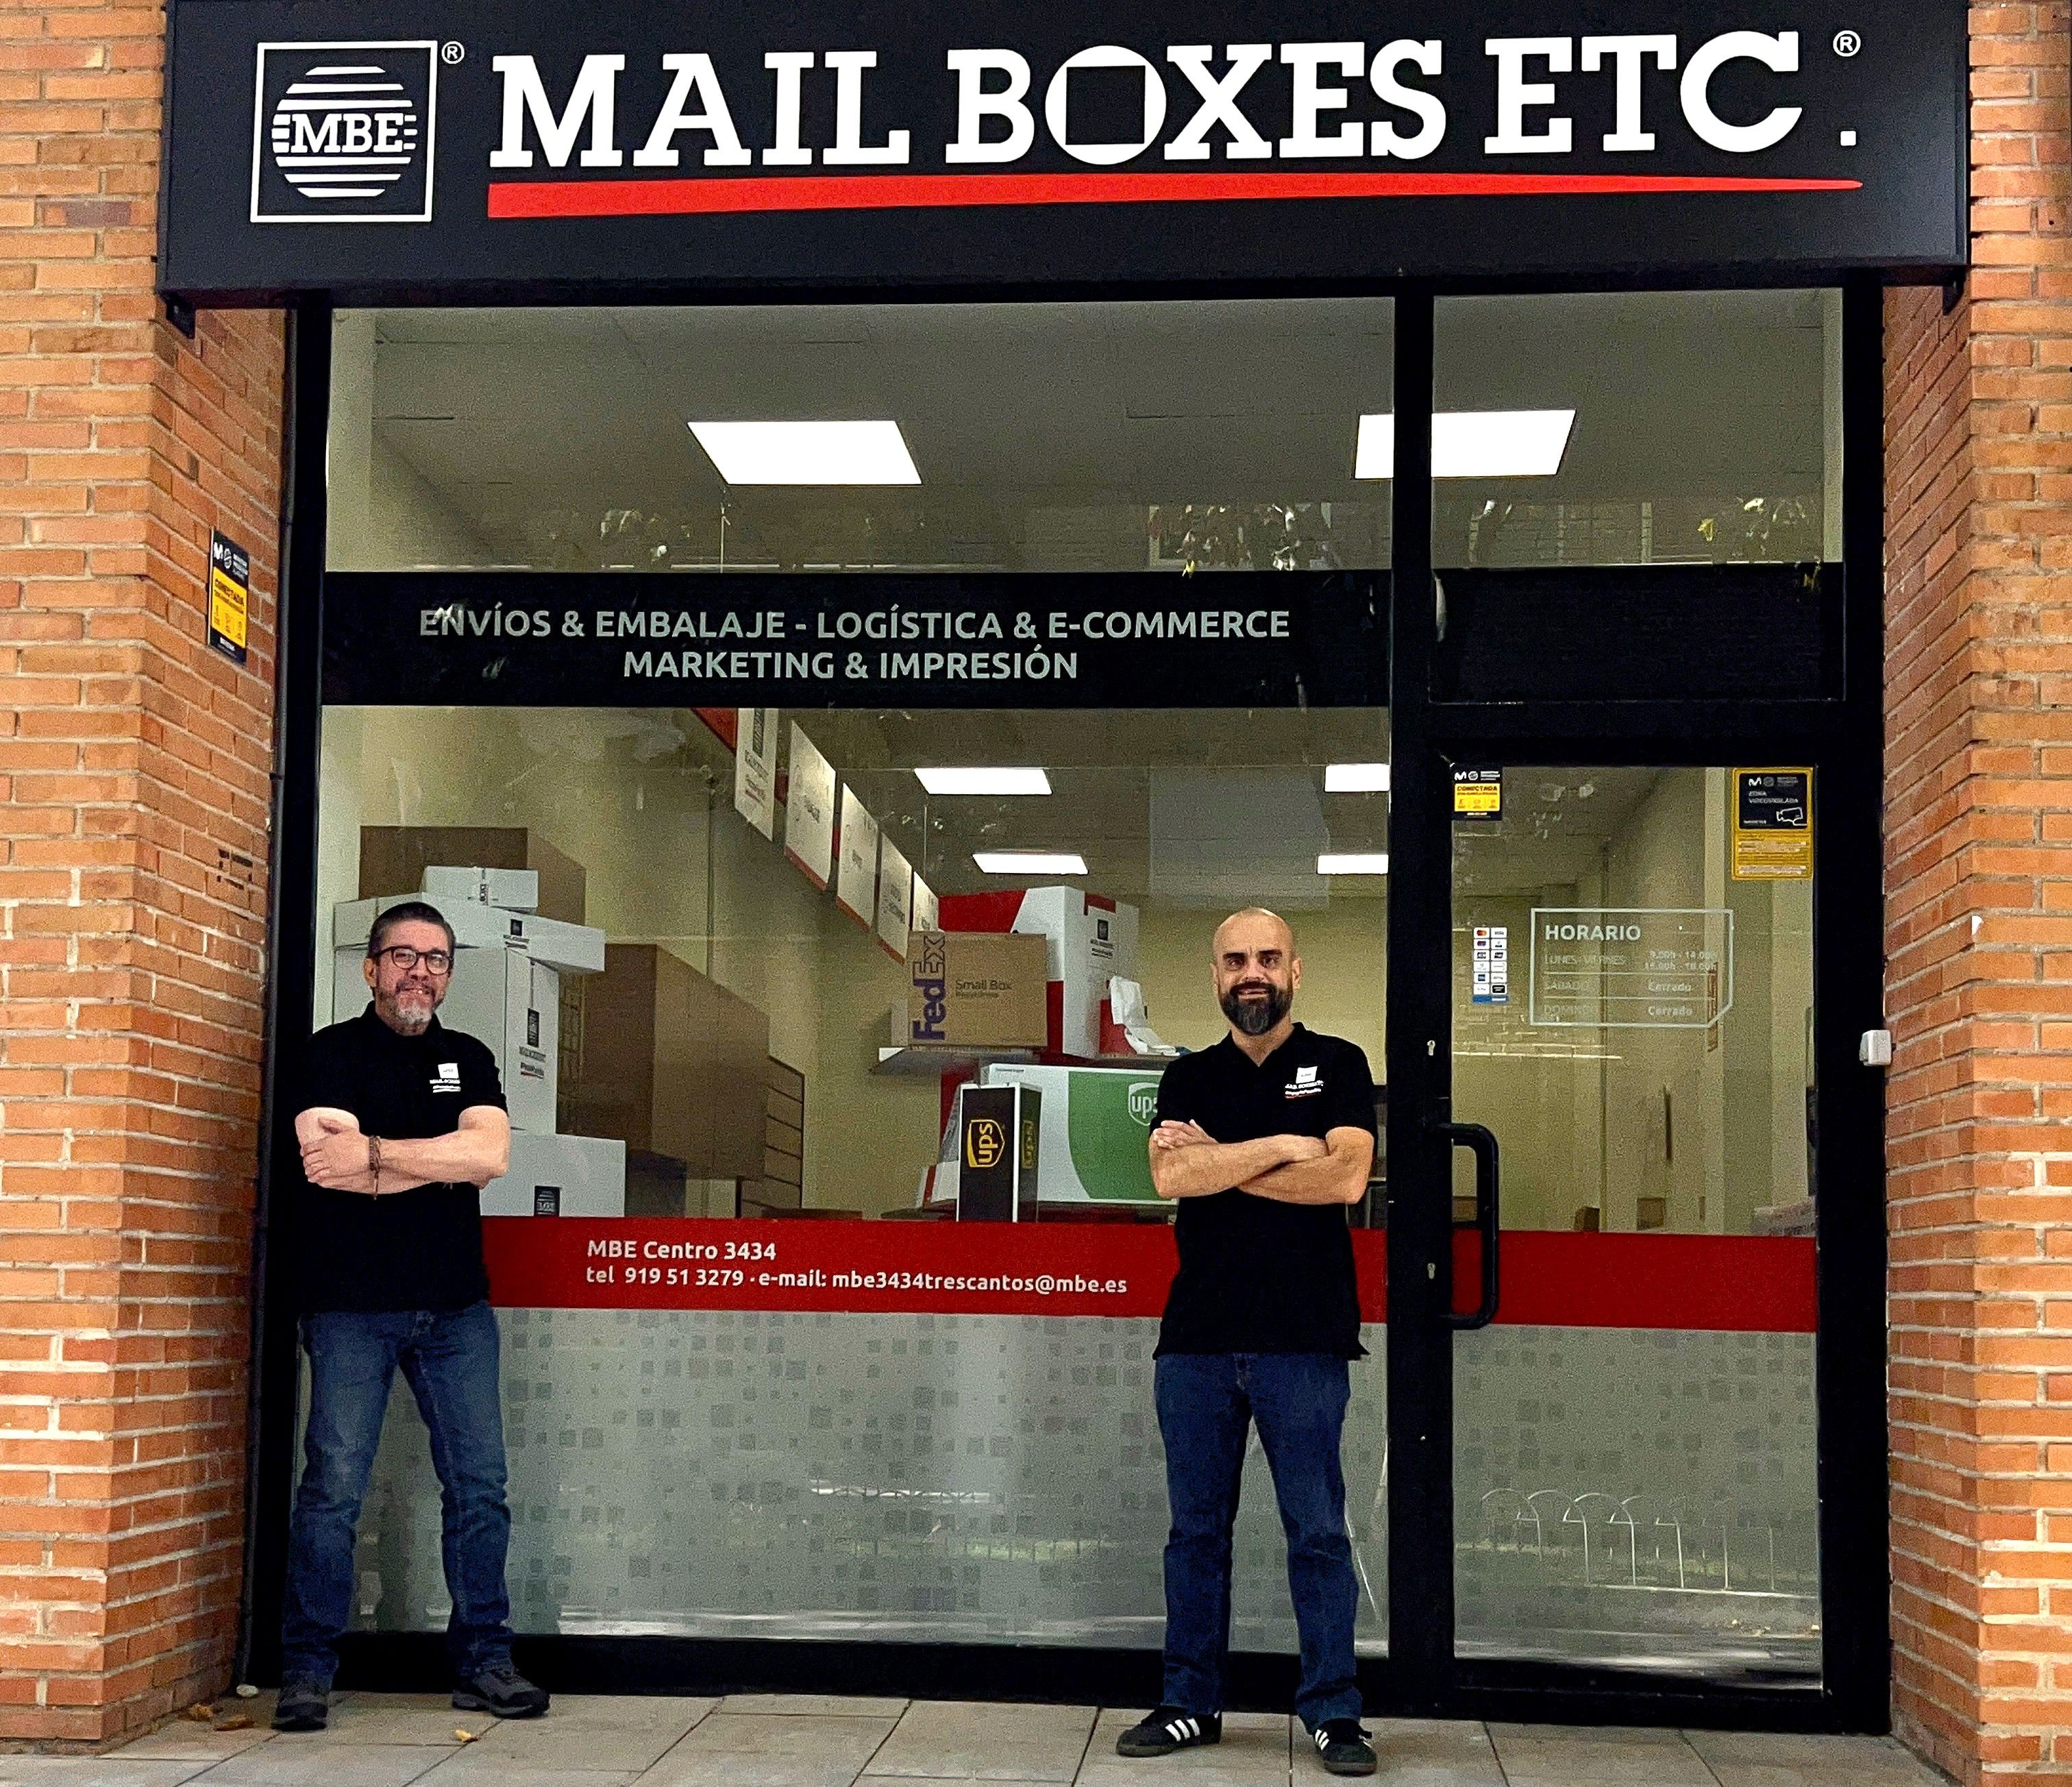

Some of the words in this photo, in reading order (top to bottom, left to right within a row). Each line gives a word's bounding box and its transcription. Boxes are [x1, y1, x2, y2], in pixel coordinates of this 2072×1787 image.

[490, 51, 910, 168] MAIL
[946, 39, 1446, 165] BOXES
[291, 112, 404, 153] MBE
[420, 602, 551, 637] ENVÍOS
[561, 611, 585, 637] &
[596, 611, 785, 638] EMBALAJE
[817, 604, 1003, 639] LOGÍSTICA
[1013, 612, 1037, 639] &
[1048, 611, 1290, 639] E-COMMERCE
[624, 651, 834, 679] MARKETING
[845, 652, 869, 679] &
[880, 644, 1077, 680] IMPRESIÓN
[1545, 925, 1641, 941] HORARIO
[912, 934, 946, 1041] FedEx
[956, 979, 987, 990] Small
[989, 980, 1013, 991] Box
[978, 1123, 998, 1163] ups
[587, 1240, 637, 1259] MBE
[643, 1242, 718, 1259] Centro
[724, 1242, 776, 1261] 3434
[587, 1266, 615, 1283] tel
[625, 1268, 661, 1284] 919
[666, 1269, 688, 1285] 51
[695, 1270, 744, 1286] 3279
[758, 1269, 827, 1287] e-mail:
[832, 1270, 1127, 1295] mbe3434trescantos@mbe.es
